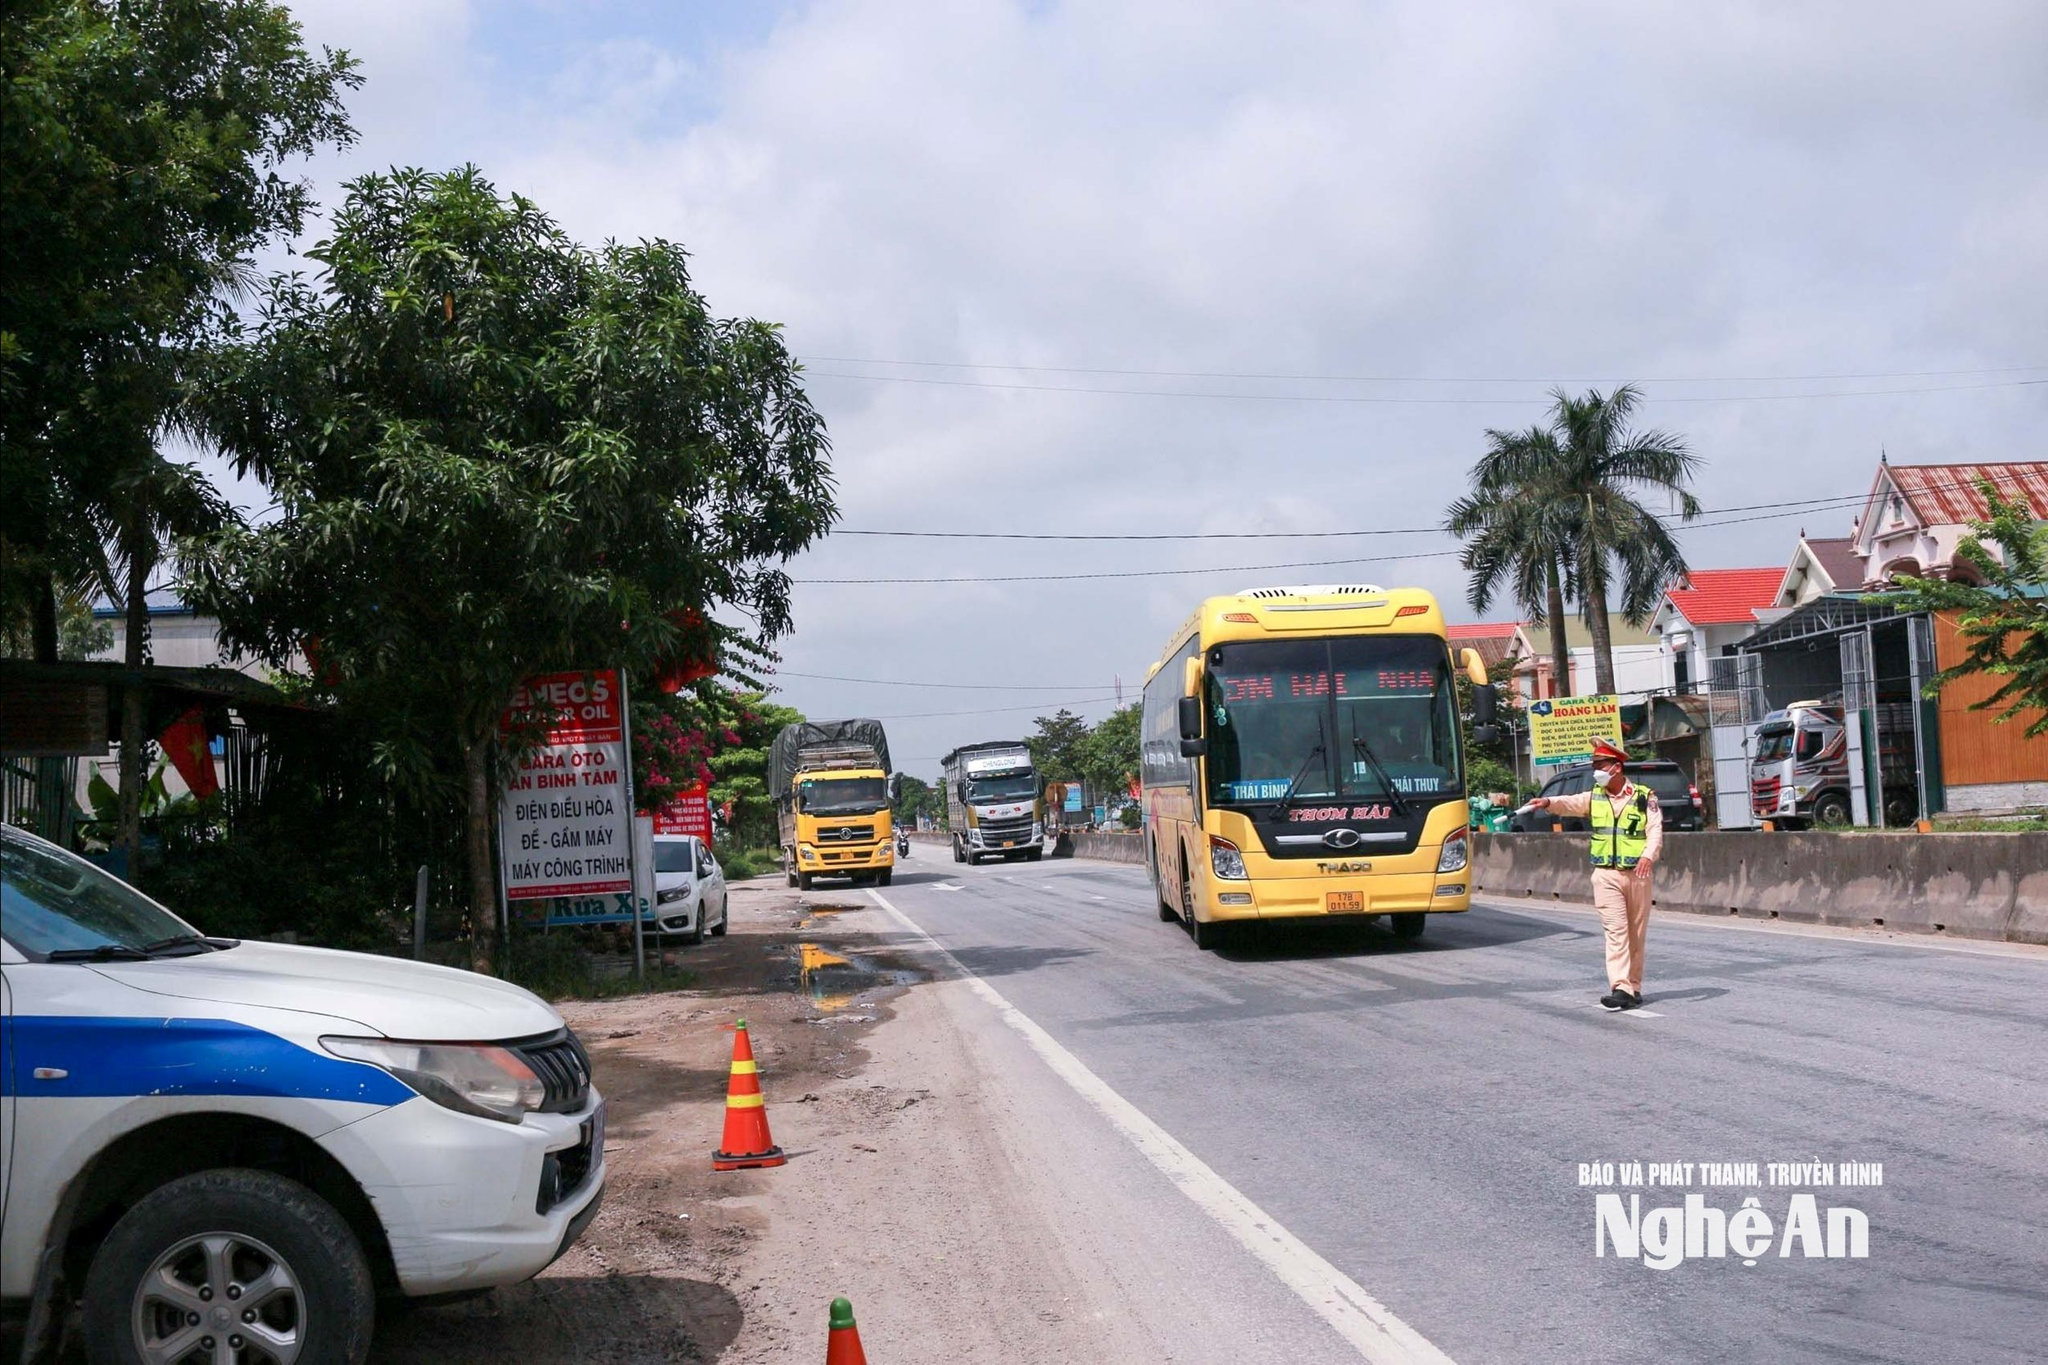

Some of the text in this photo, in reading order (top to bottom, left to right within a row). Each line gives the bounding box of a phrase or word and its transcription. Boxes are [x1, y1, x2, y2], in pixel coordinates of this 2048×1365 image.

[581, 705, 610, 720] OIL
[1594, 703, 1616, 714] LÂM
[1234, 782, 1258, 799] THÁI
[515, 800, 547, 825] ĐIỆN
[586, 795, 614, 817] HÒA
[1289, 806, 1348, 822] THƠM
[585, 825, 613, 847] MÁY
[512, 854, 625, 880] MÁY CÔNG TRÌNH
[1317, 861, 1372, 875] THACO
[615, 893, 648, 914] Xe
